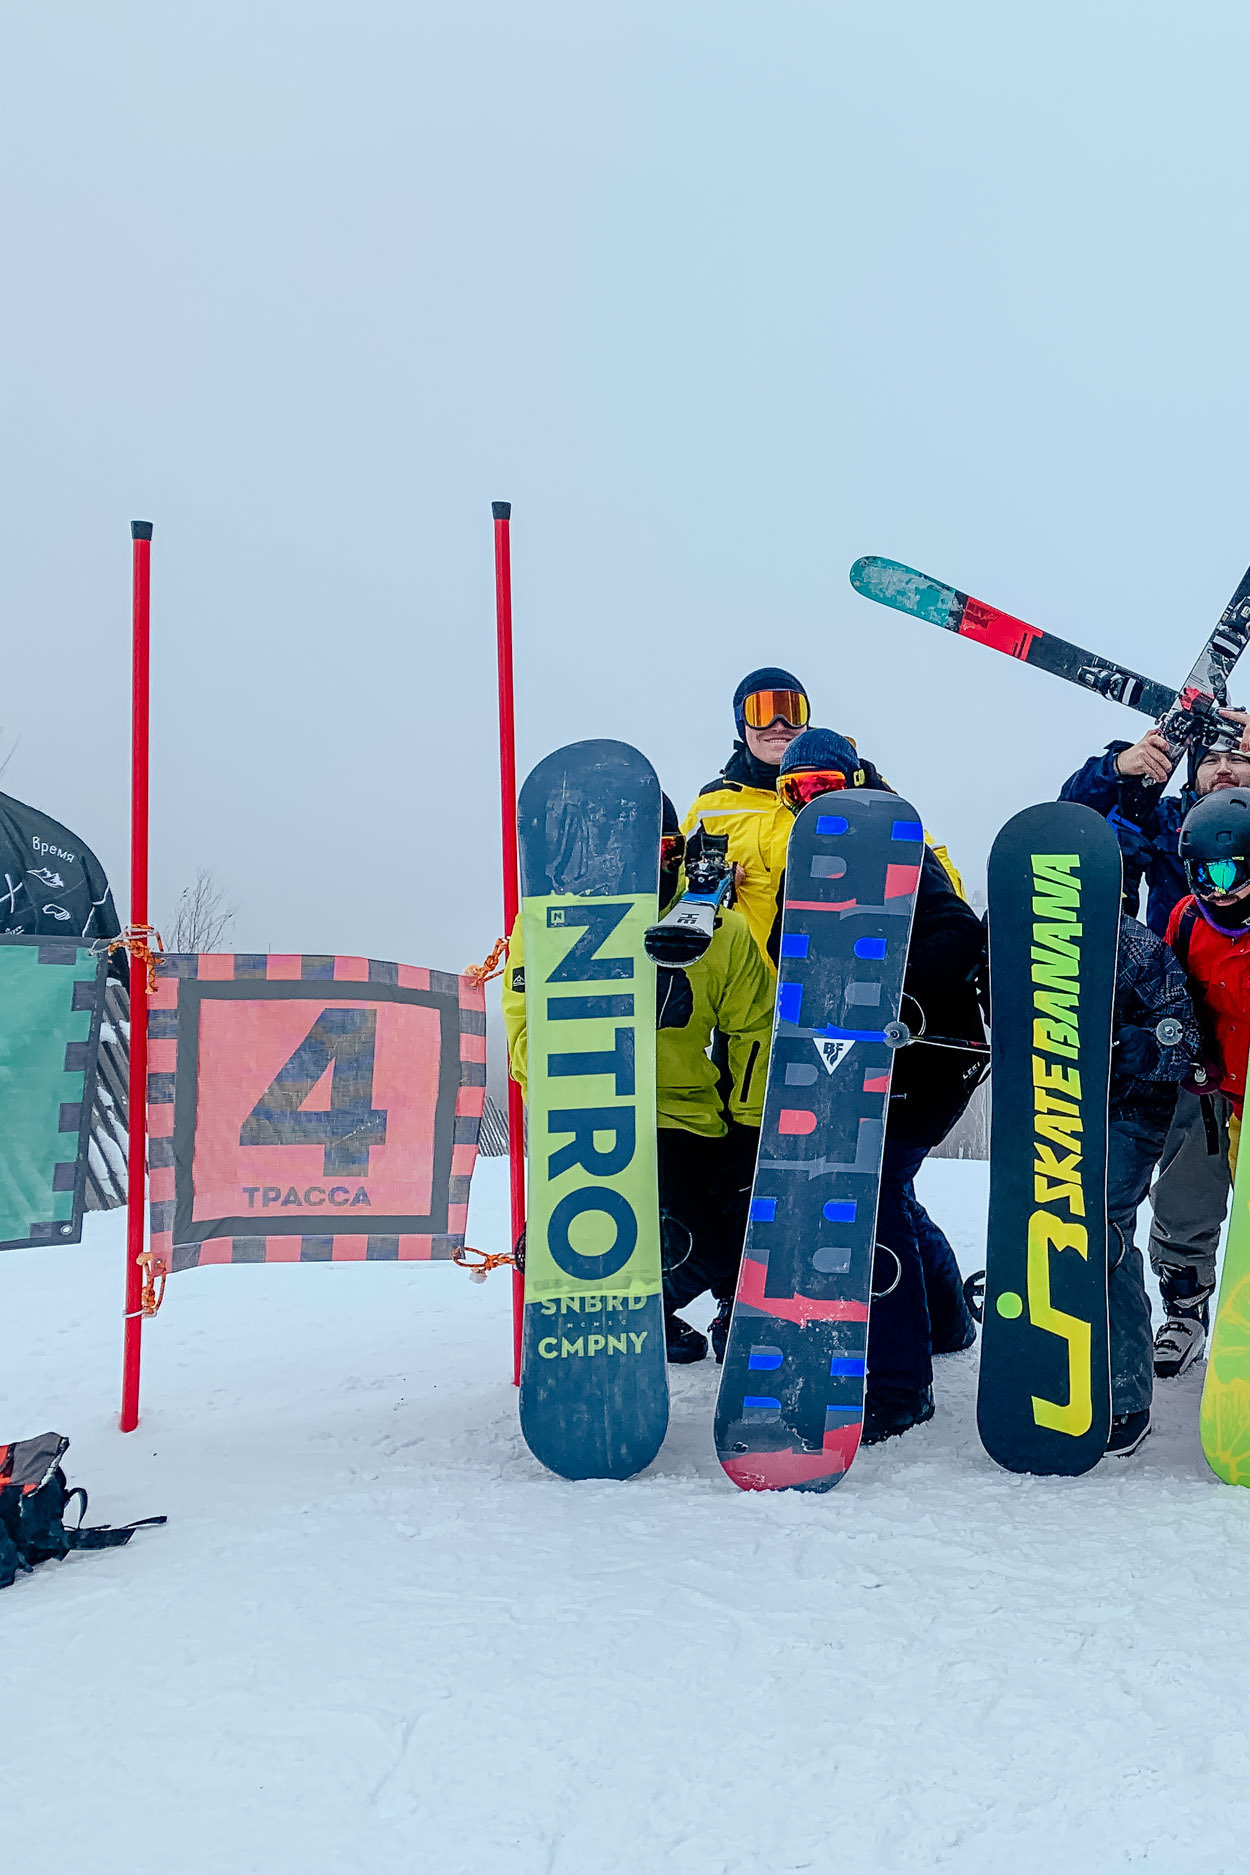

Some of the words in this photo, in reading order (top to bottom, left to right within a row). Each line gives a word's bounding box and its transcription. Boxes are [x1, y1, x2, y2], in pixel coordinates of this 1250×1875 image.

[32, 836, 76, 863] Время
[1030, 853, 1083, 1061] BANANA
[239, 1007, 388, 1178] 4
[545, 902, 639, 1281] NITRO
[1032, 1053, 1086, 1217] SKATE
[242, 1186, 373, 1208] ТРАССА
[537, 1331, 649, 1360] CMPNY
[540, 1295, 649, 1316] SNBRD
